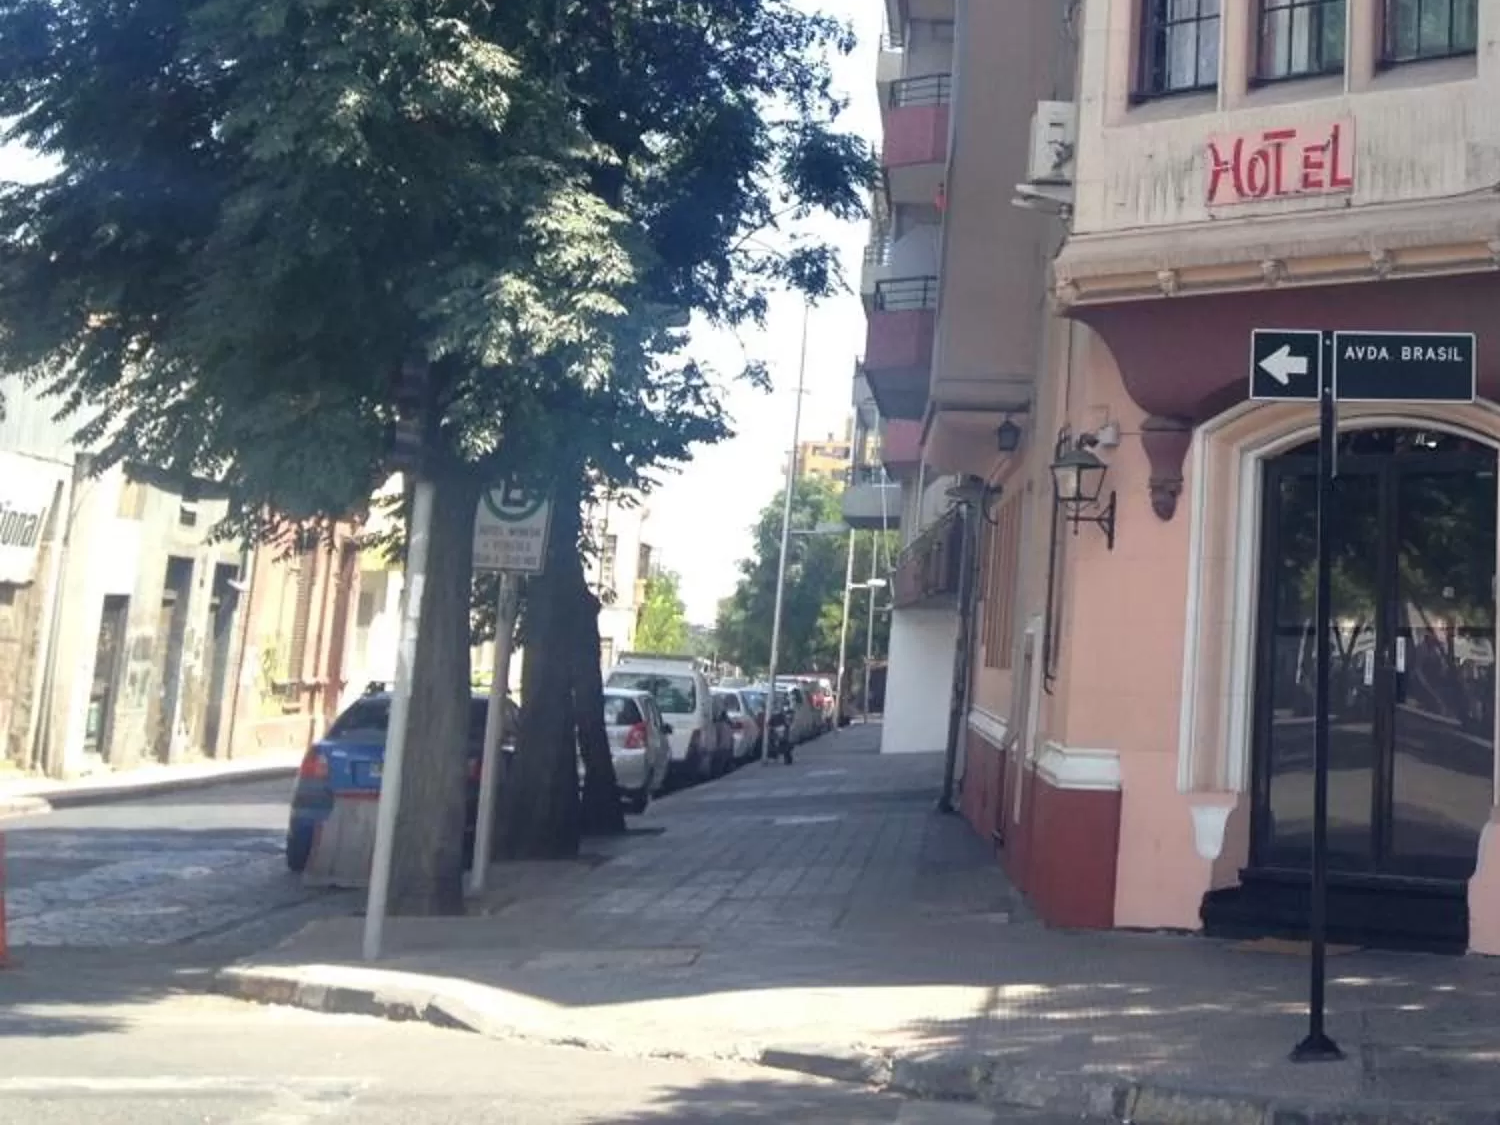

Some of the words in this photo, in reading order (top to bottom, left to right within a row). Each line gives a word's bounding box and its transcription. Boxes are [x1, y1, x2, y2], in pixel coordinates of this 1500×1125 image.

[1207, 123, 1353, 202] HOTEL
[1401, 346, 1464, 362] BRASIL
[0, 499, 46, 548] ional
